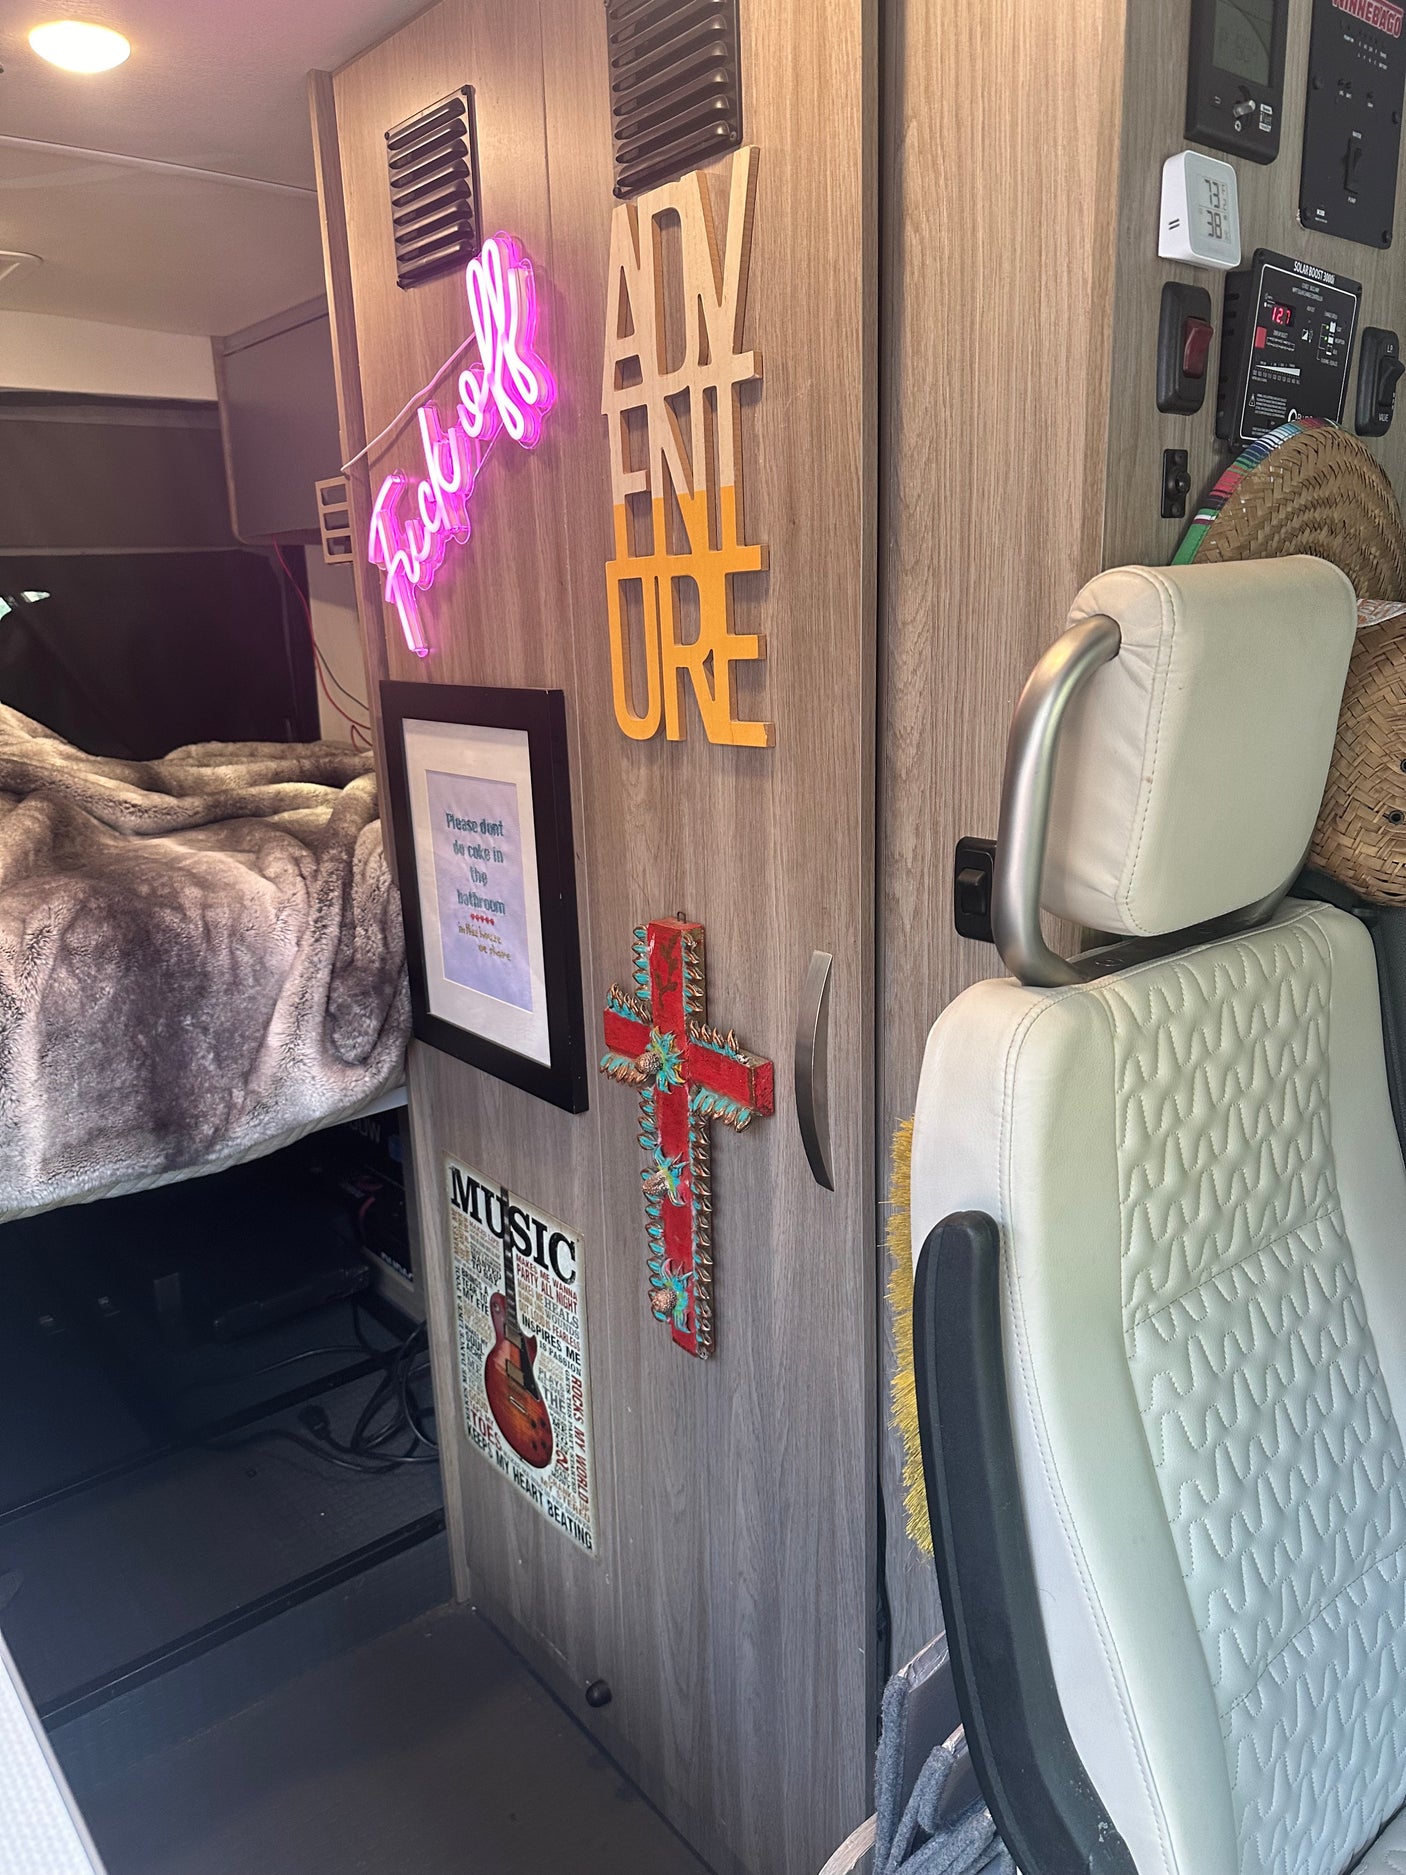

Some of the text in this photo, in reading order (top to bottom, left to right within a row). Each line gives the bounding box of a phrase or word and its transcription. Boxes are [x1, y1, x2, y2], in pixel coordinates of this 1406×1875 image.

[1206, 210, 1223, 240] 38
[1293, 261, 1309, 275] SOLAR
[1308, 265, 1324, 281] BOOST
[1272, 306, 1291, 325] 12.7
[457, 232, 555, 448] off
[604, 545, 776, 748] URE
[446, 813, 478, 834] Please
[453, 840, 504, 863] do coke in
[470, 866, 488, 886] the
[457, 889, 506, 915] bathroom
[450, 1166, 577, 1286] MUSIC
[471, 1259, 481, 1274] TO
[516, 1254, 538, 1274] MAKES
[539, 1270, 550, 1282] ME
[551, 1278, 577, 1301] WANNA
[462, 1277, 487, 1305] TEAR TO
[462, 1286, 489, 1316] MY EYE
[484, 1285, 489, 1296] A
[516, 1263, 538, 1289] PARTY
[541, 1280, 554, 1300] ALL
[556, 1291, 578, 1316] NIGHT
[544, 1296, 578, 1329] HEALS
[544, 1308, 579, 1340] WOUNDS
[521, 1314, 561, 1352] INSPIRES
[565, 1346, 580, 1366] ME
[552, 1325, 580, 1352] FEARLESS
[539, 1339, 547, 1351] IS
[548, 1347, 581, 1377] PASSION
[542, 1385, 566, 1415] THE
[470, 1409, 502, 1452] TOES
[571, 1373, 588, 1505] ROCKS MY WORLD
[555, 1448, 569, 1471] 2
[467, 1422, 493, 1459] KEEPS
[496, 1452, 509, 1473] MY
[513, 1466, 543, 1506] HEART
[547, 1500, 592, 1550] BEATING
